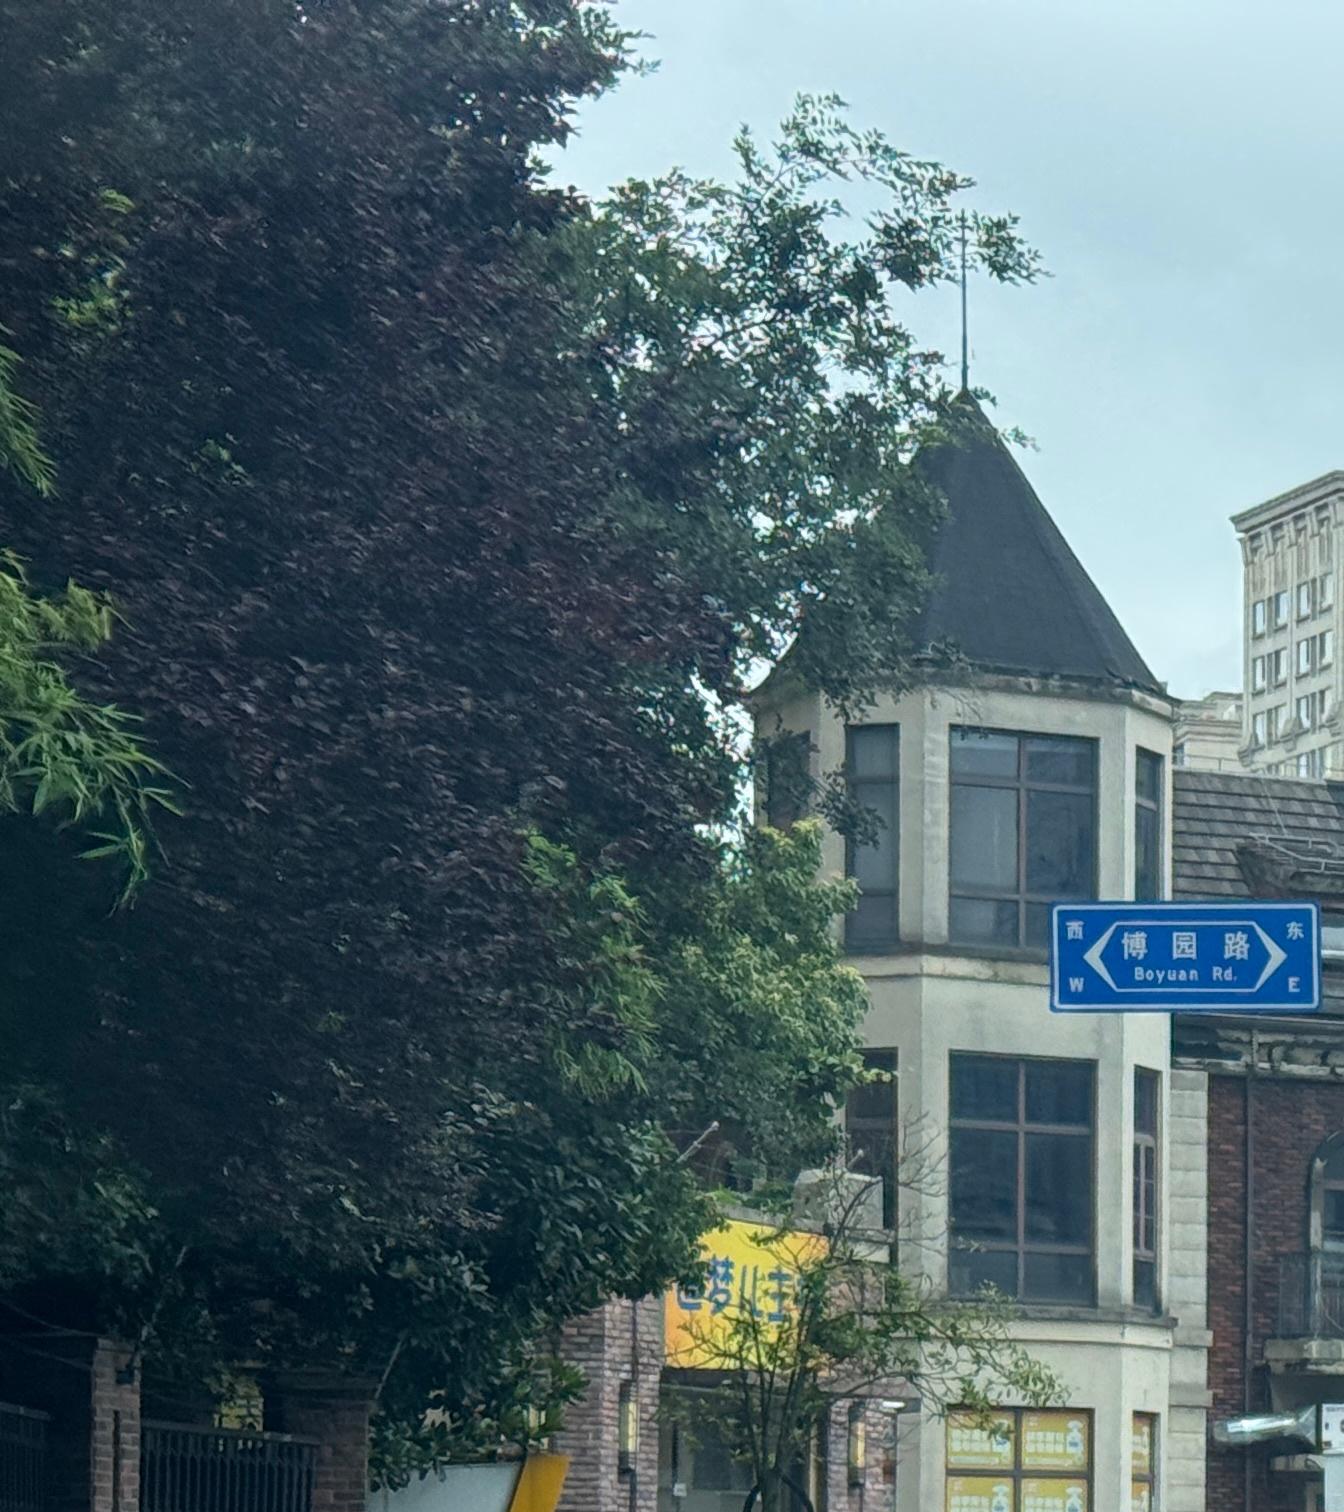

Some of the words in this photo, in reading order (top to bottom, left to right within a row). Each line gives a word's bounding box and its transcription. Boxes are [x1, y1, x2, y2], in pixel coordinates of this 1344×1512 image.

[1066, 921, 1084, 940] 西
[1286, 921, 1304, 940] 东
[1122, 931, 1250, 960] 博园路
[1134, 966, 1199, 984] Boyuan
[1212, 966, 1238, 982] Rd.
[1069, 977, 1084, 993] W
[1288, 977, 1301, 993] E
